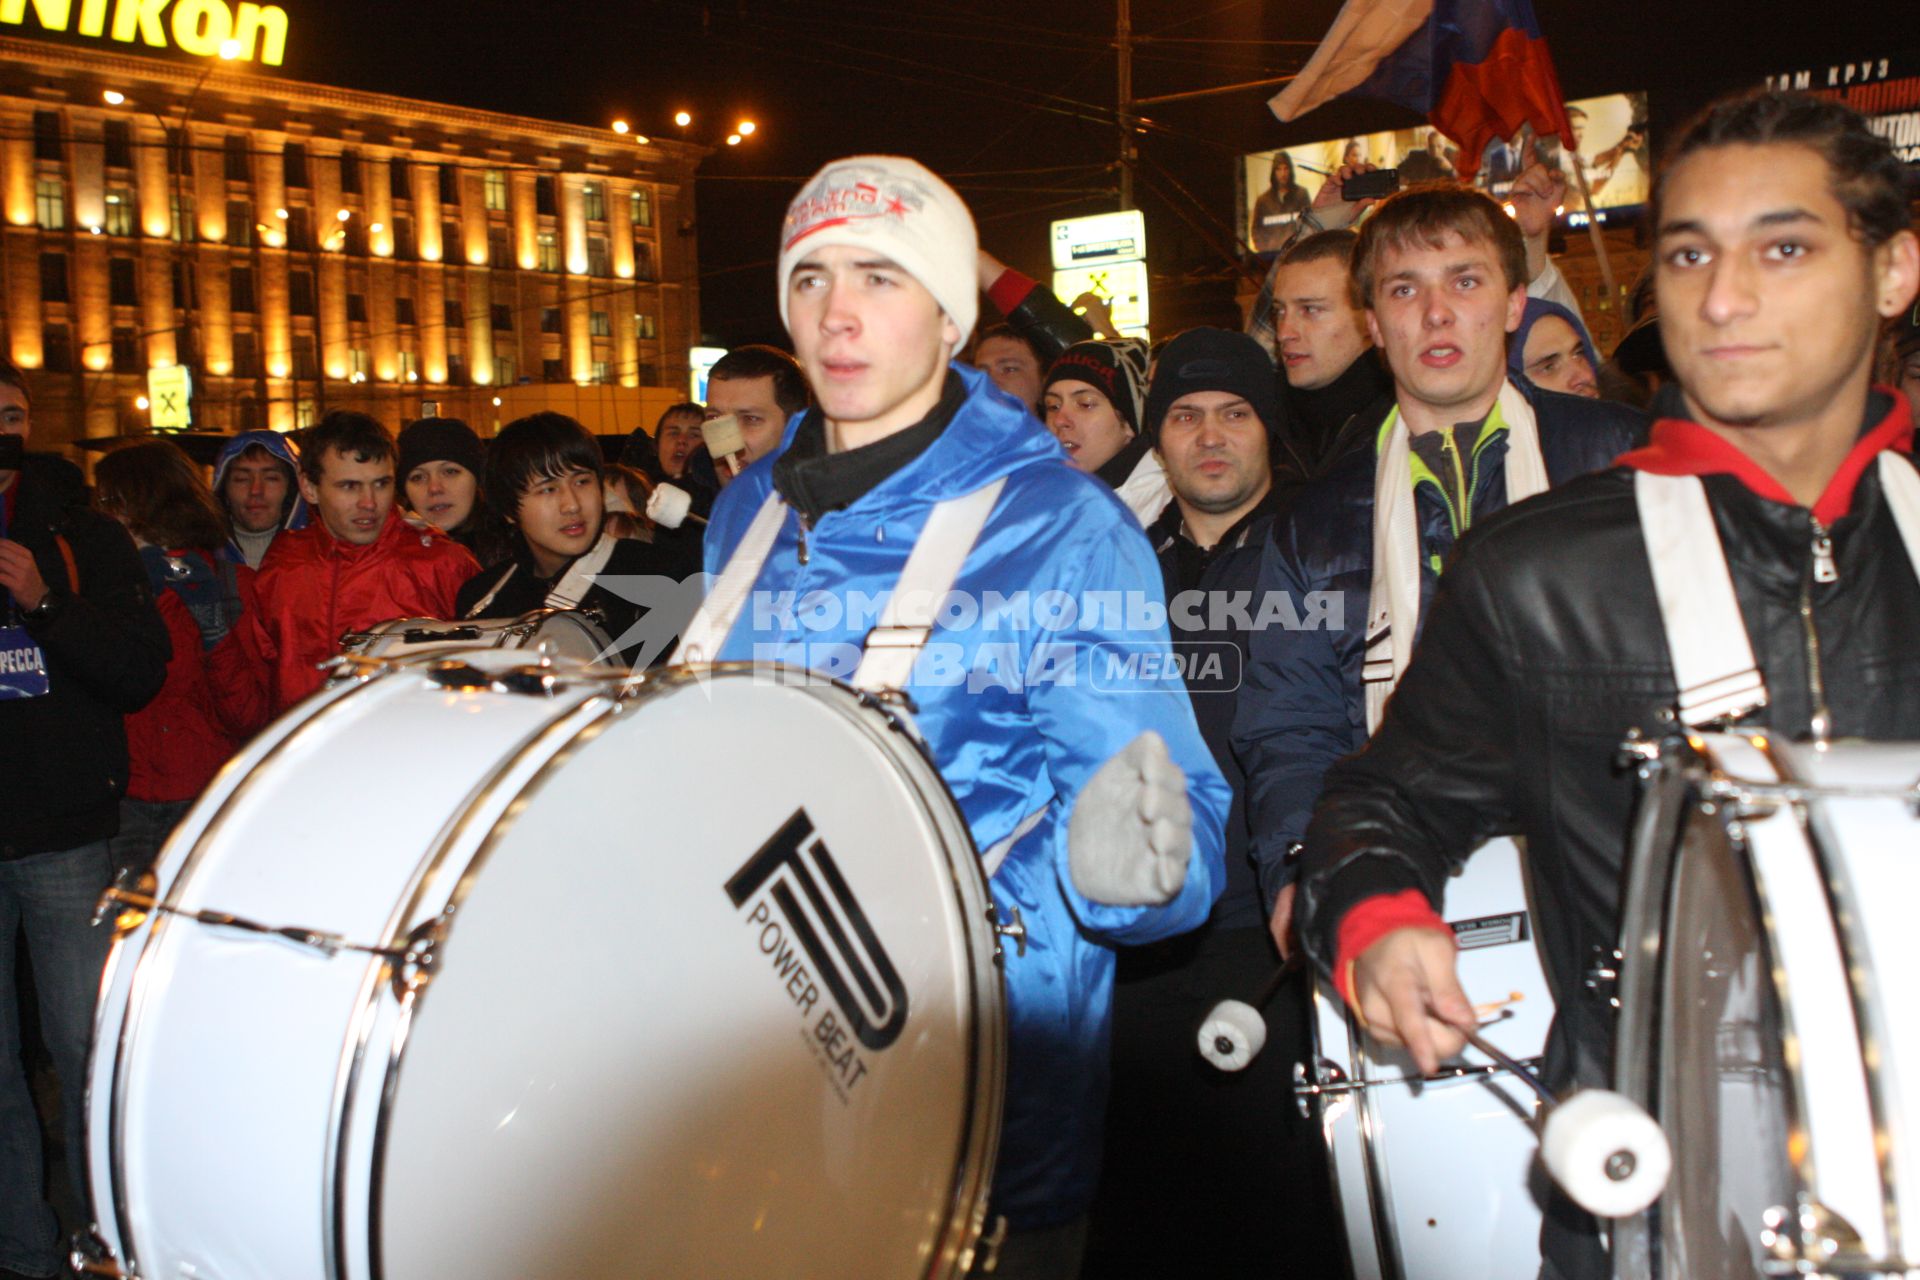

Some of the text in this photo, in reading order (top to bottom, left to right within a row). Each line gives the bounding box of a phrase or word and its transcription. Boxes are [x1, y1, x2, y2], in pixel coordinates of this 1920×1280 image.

[0, 0, 288, 66] Nikon
[1766, 58, 1888, 92] ТОМ КРУЗ
[747, 899, 820, 1017] POWER
[813, 1009, 868, 1088] BEAT
